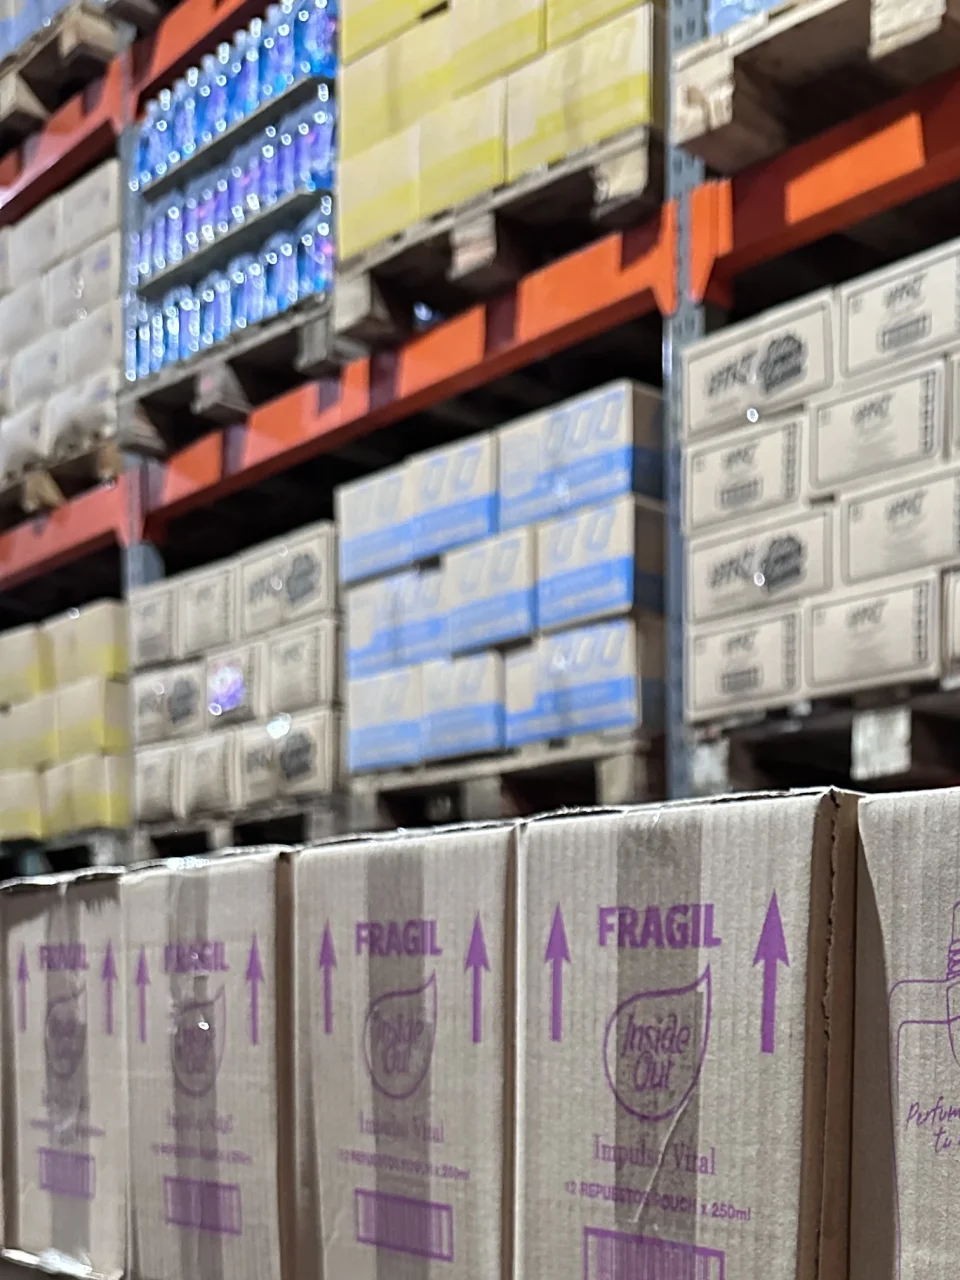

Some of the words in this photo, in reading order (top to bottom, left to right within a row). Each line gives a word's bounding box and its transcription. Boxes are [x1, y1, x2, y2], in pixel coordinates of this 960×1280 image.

[356, 920, 443, 956] FRAGIL
[597, 904, 722, 948] FRAGIL
[622, 1013, 691, 1056] Inside
[934, 1127, 951, 1152] tu
[712, 1202, 751, 1221] 250ml
